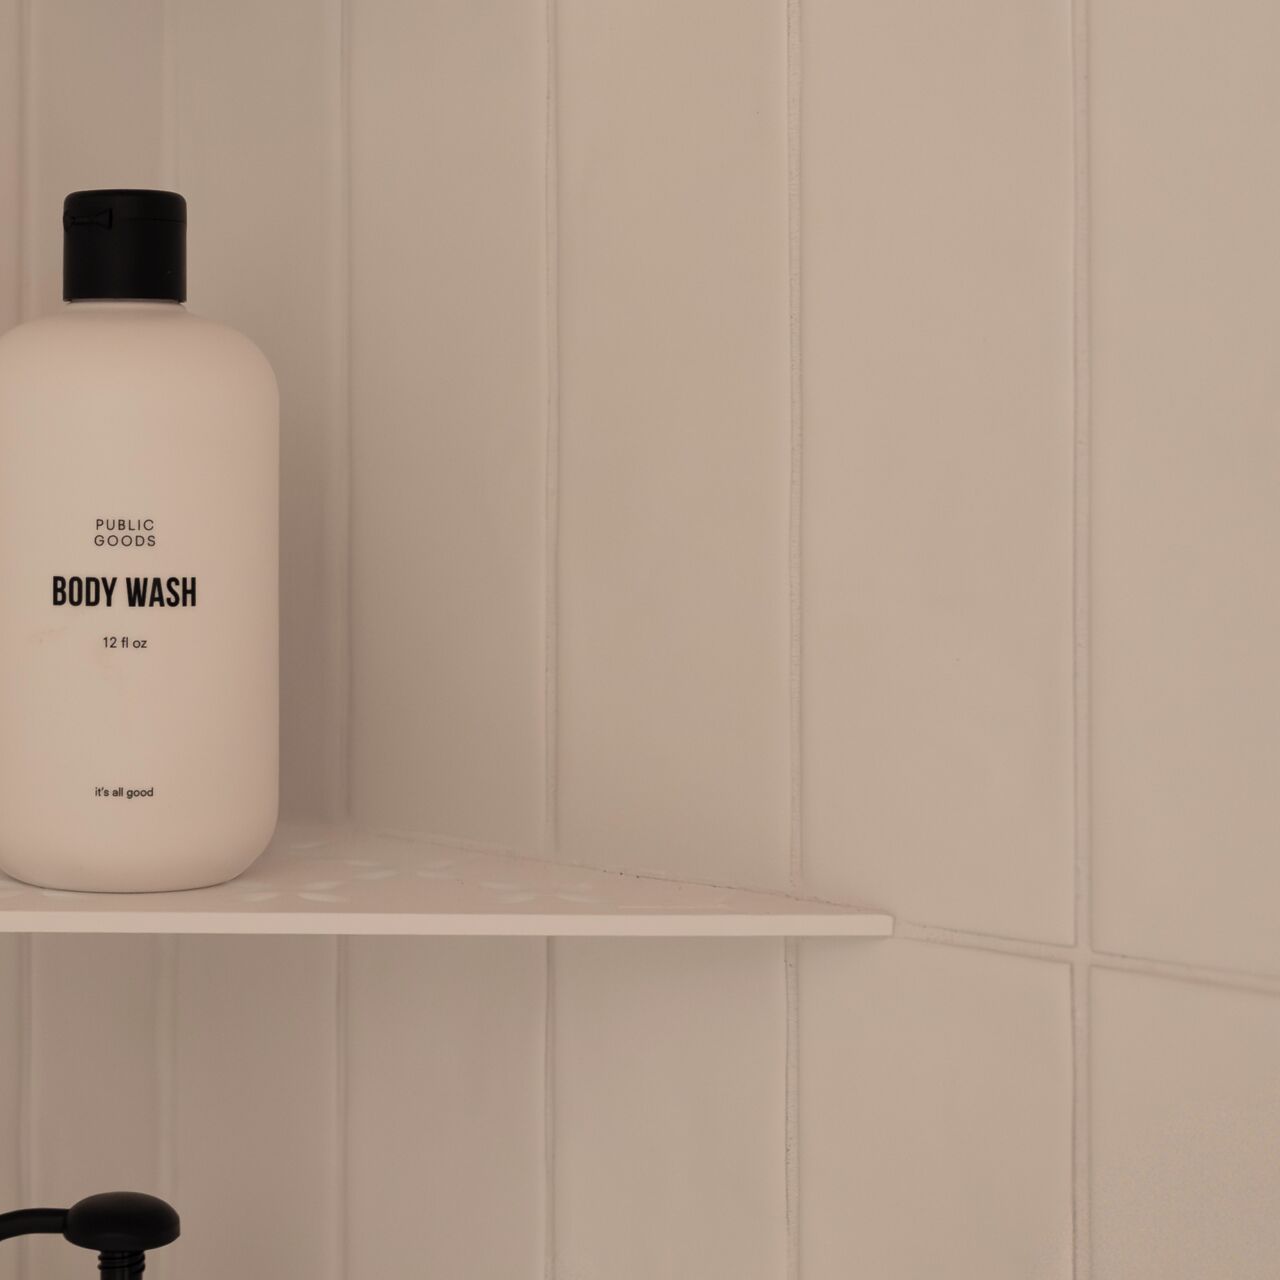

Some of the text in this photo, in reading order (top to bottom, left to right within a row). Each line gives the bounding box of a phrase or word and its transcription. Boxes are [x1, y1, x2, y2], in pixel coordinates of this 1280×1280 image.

[96, 518, 154, 531] PUBLIC
[94, 535, 156, 548] GOODS
[53, 576, 197, 608] BODY WASH
[103, 636, 147, 649] 12 fl oz
[95, 787, 154, 800] it's all good
